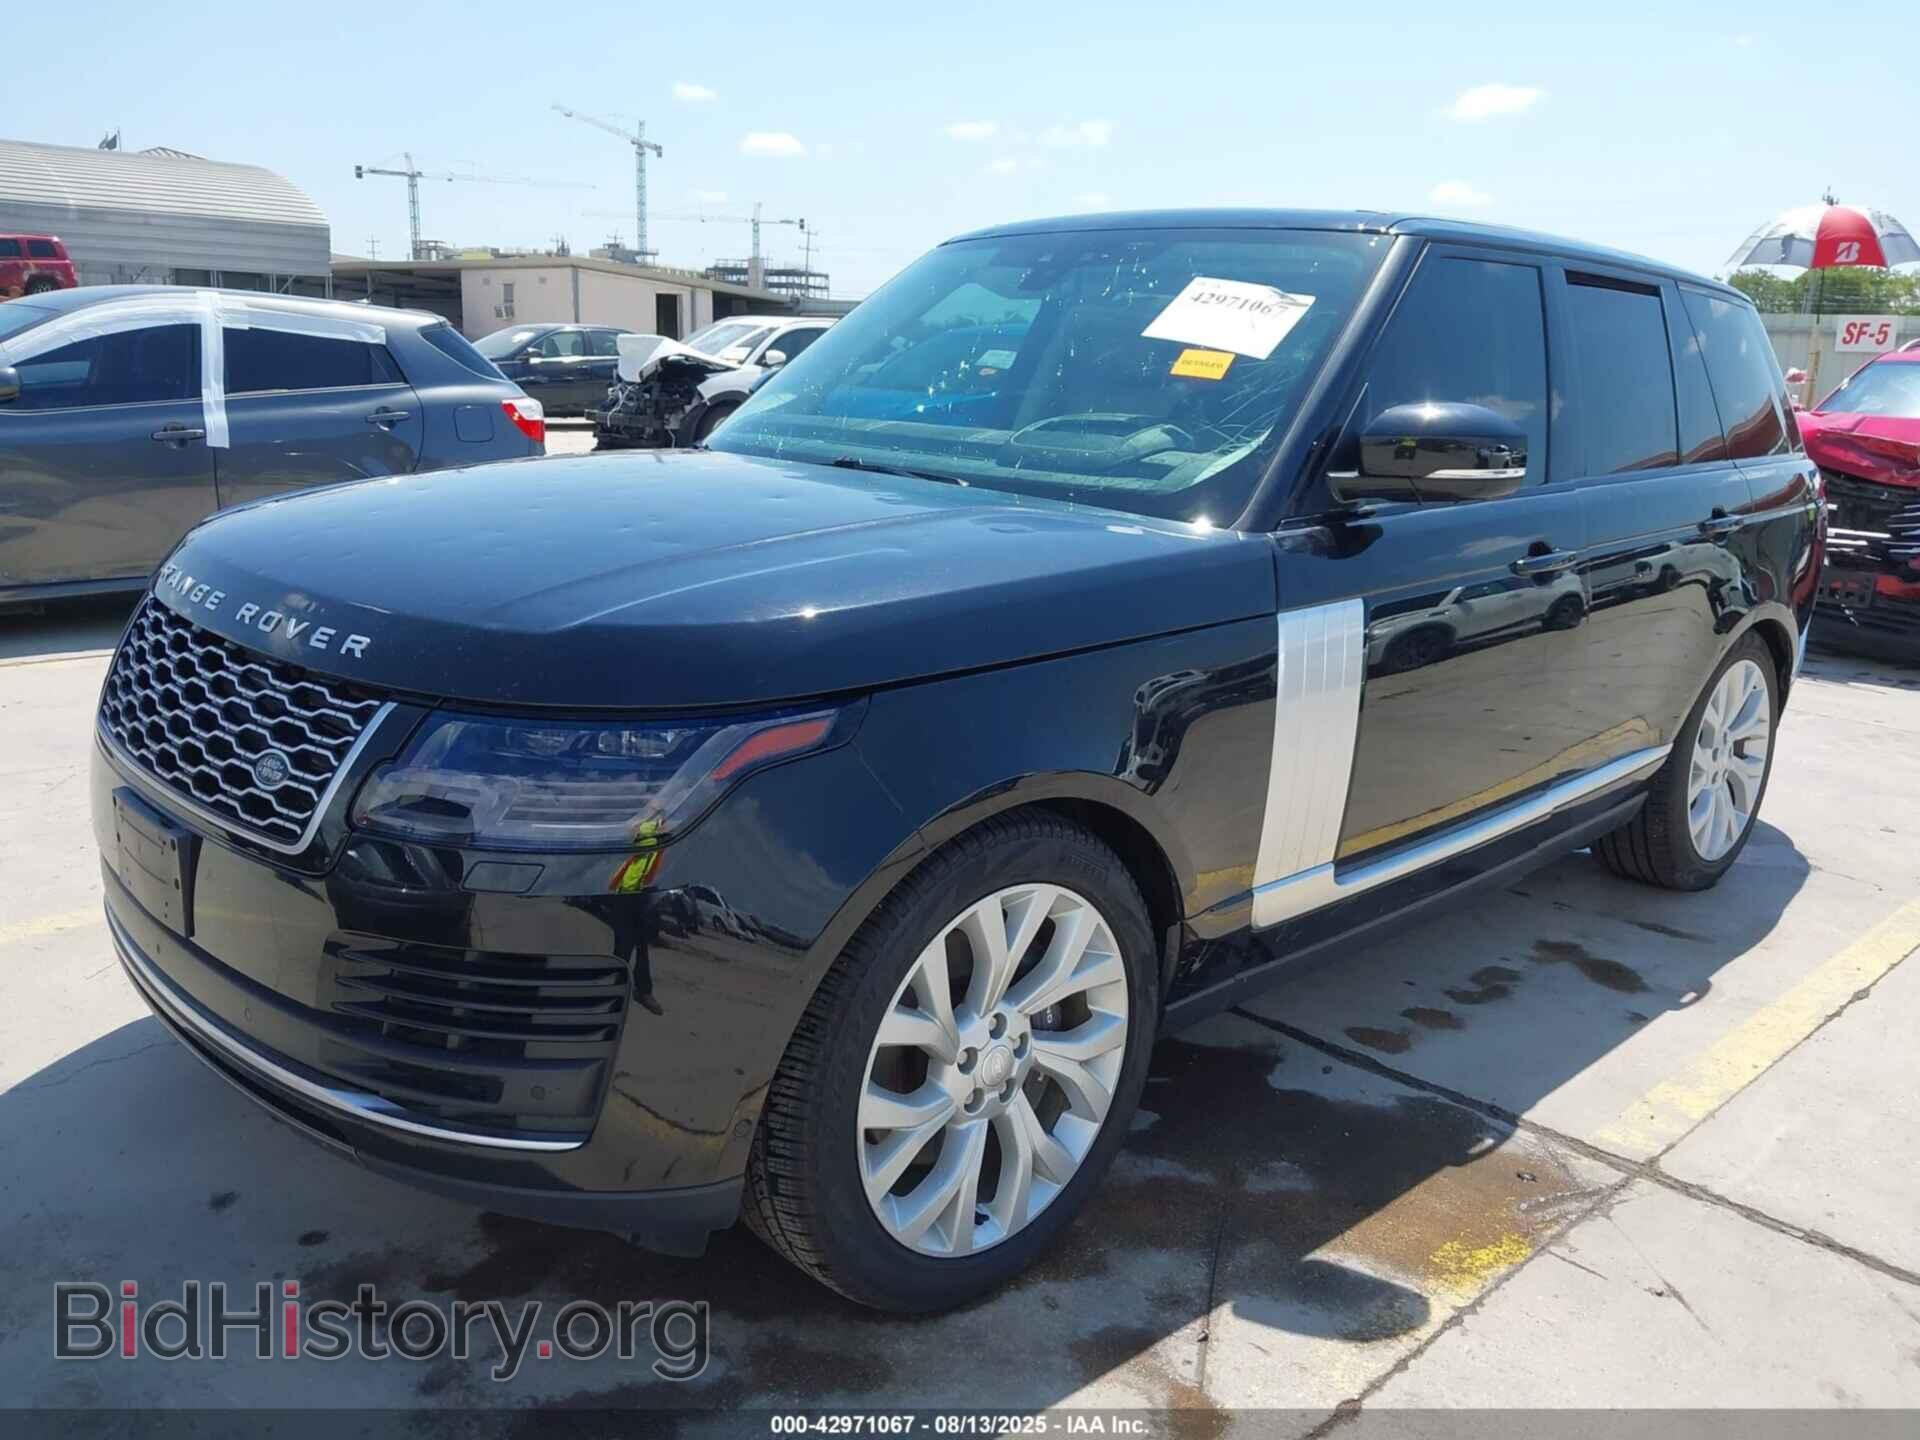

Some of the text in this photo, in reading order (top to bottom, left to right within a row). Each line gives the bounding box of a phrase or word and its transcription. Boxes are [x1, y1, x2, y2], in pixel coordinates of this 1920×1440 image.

[1191, 291, 1289, 317] 42971067
[1842, 322, 1892, 345] SF-5
[160, 563, 371, 659] RANGE ROVER
